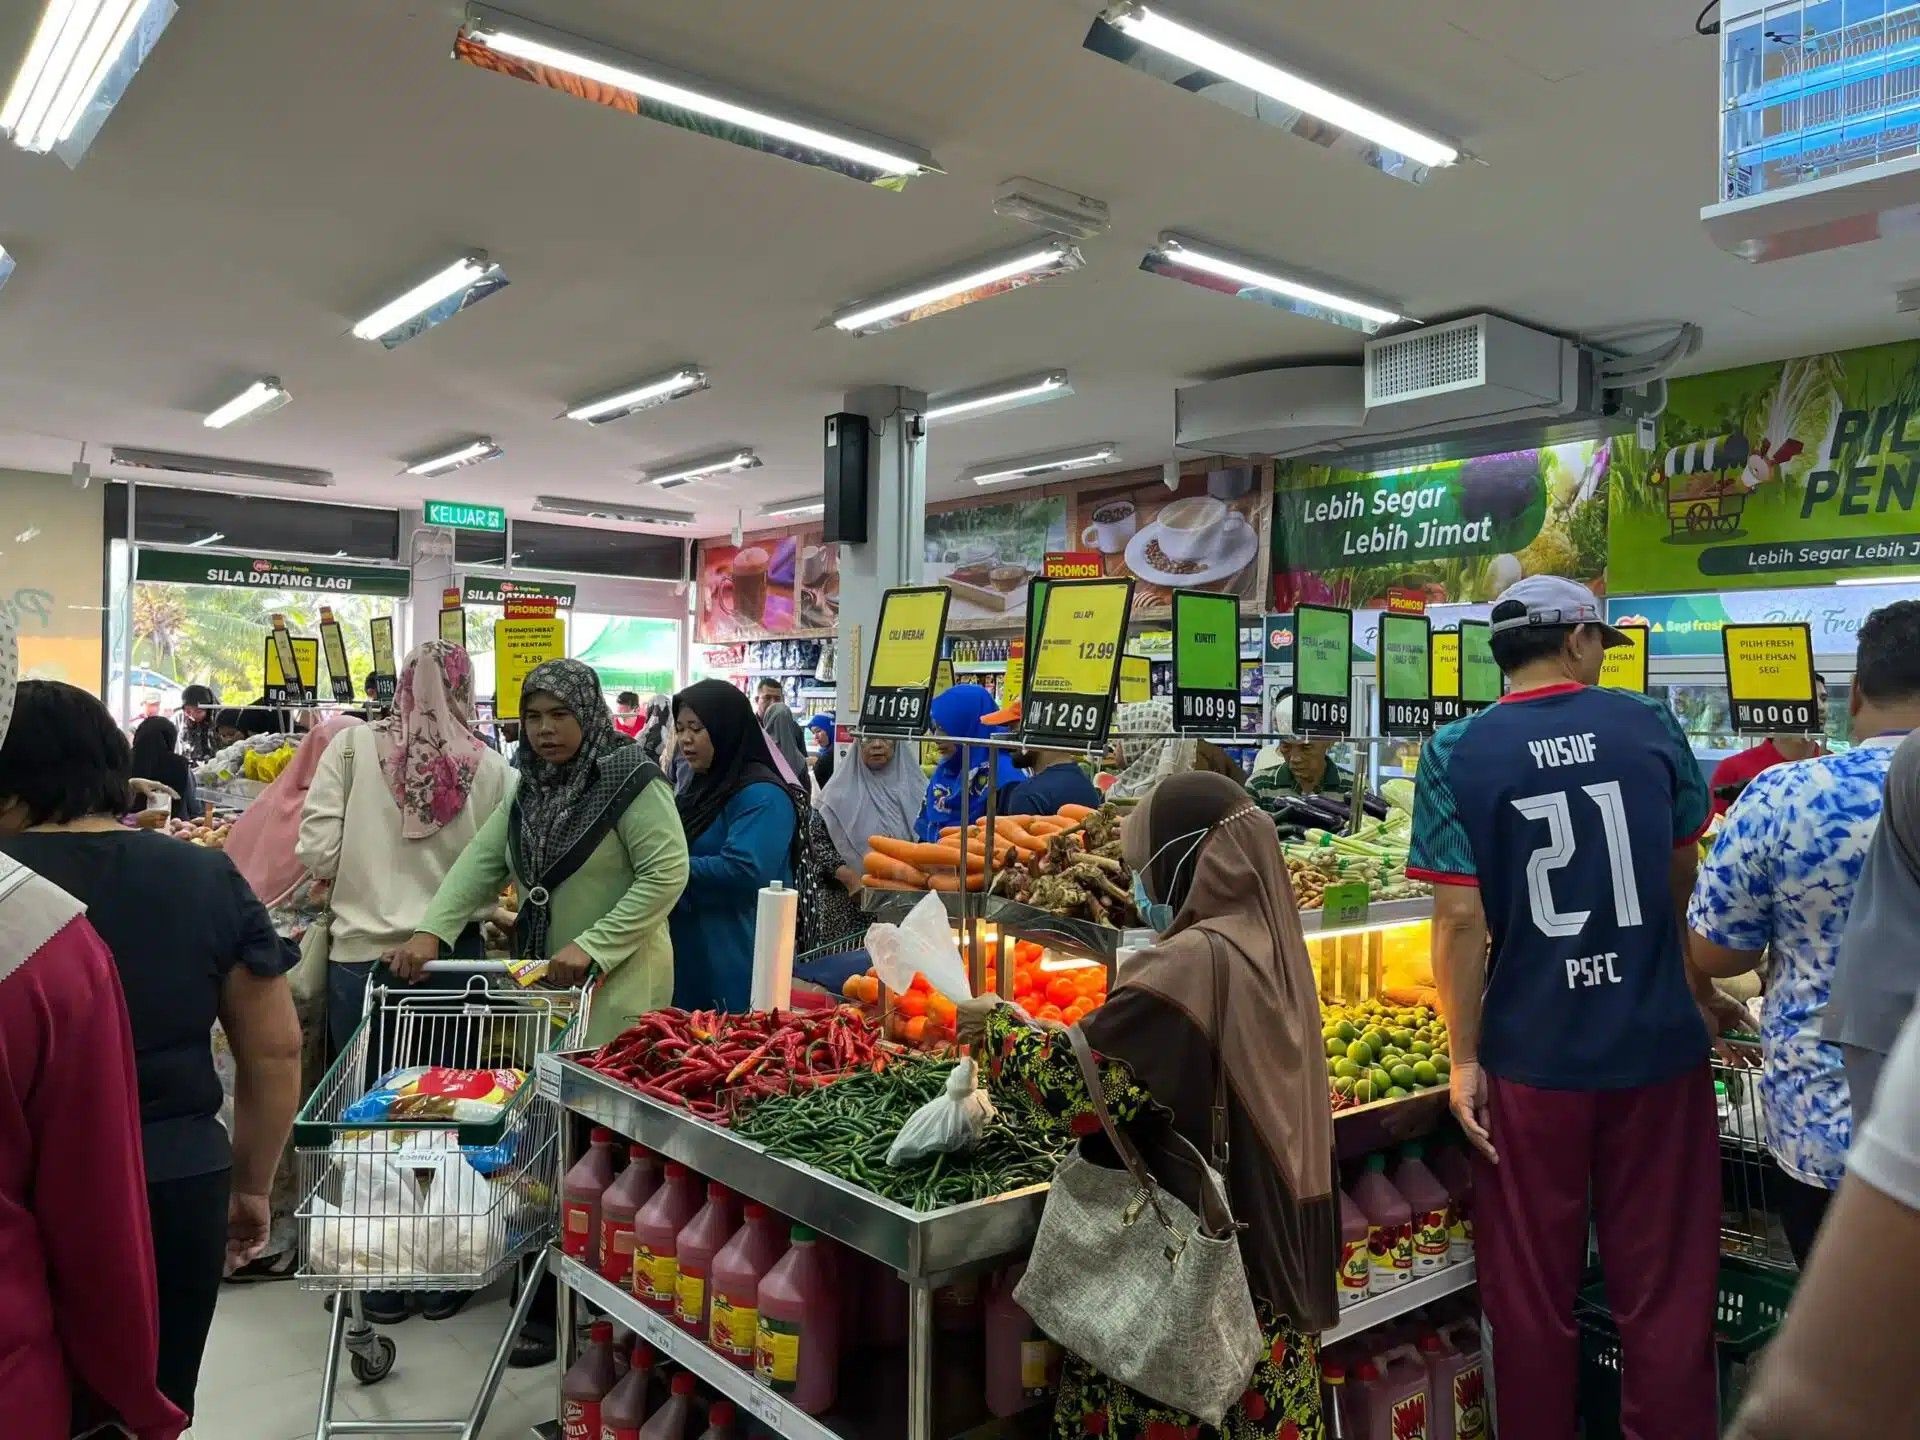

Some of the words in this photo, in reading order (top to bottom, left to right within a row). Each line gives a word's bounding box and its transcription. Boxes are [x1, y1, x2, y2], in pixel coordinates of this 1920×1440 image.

[1304, 492, 1365, 524] Lebih
[1371, 485, 1447, 518] Segar
[429, 505, 486, 526] KELUAR
[1343, 523, 1408, 556] Lebih
[1414, 514, 1492, 549] Jimat
[1748, 549, 1794, 566] Lebih
[1798, 548, 1851, 565] Segar
[1855, 542, 1905, 559] Lebih
[1047, 564, 1099, 577] PROMOSI
[206, 568, 245, 583] SILA
[249, 571, 312, 587] DATANG
[316, 576, 352, 590] LAGI
[467, 589, 494, 601] SILA
[507, 605, 554, 615] PROMOSI
[1390, 598, 1424, 611] PROMOSI
[889, 630, 901, 641] CILI
[901, 630, 925, 640] MERAH
[1194, 633, 1217, 644] KUNYIT
[1078, 641, 1115, 660] 12.99
[1740, 640, 1763, 648] PILIH
[1765, 640, 1795, 648] FRESH
[1608, 653, 1635, 661] EHSAN
[1740, 653, 1763, 661] PILIH
[1765, 653, 1797, 661] EHSAN
[1602, 665, 1620, 673] SEGI
[1759, 666, 1780, 674] SEGI
[1739, 705, 1750, 721] RM
[1527, 732, 1597, 769] YUSUF
[1510, 780, 1643, 938] 21
[1565, 952, 1623, 989] PSFC
